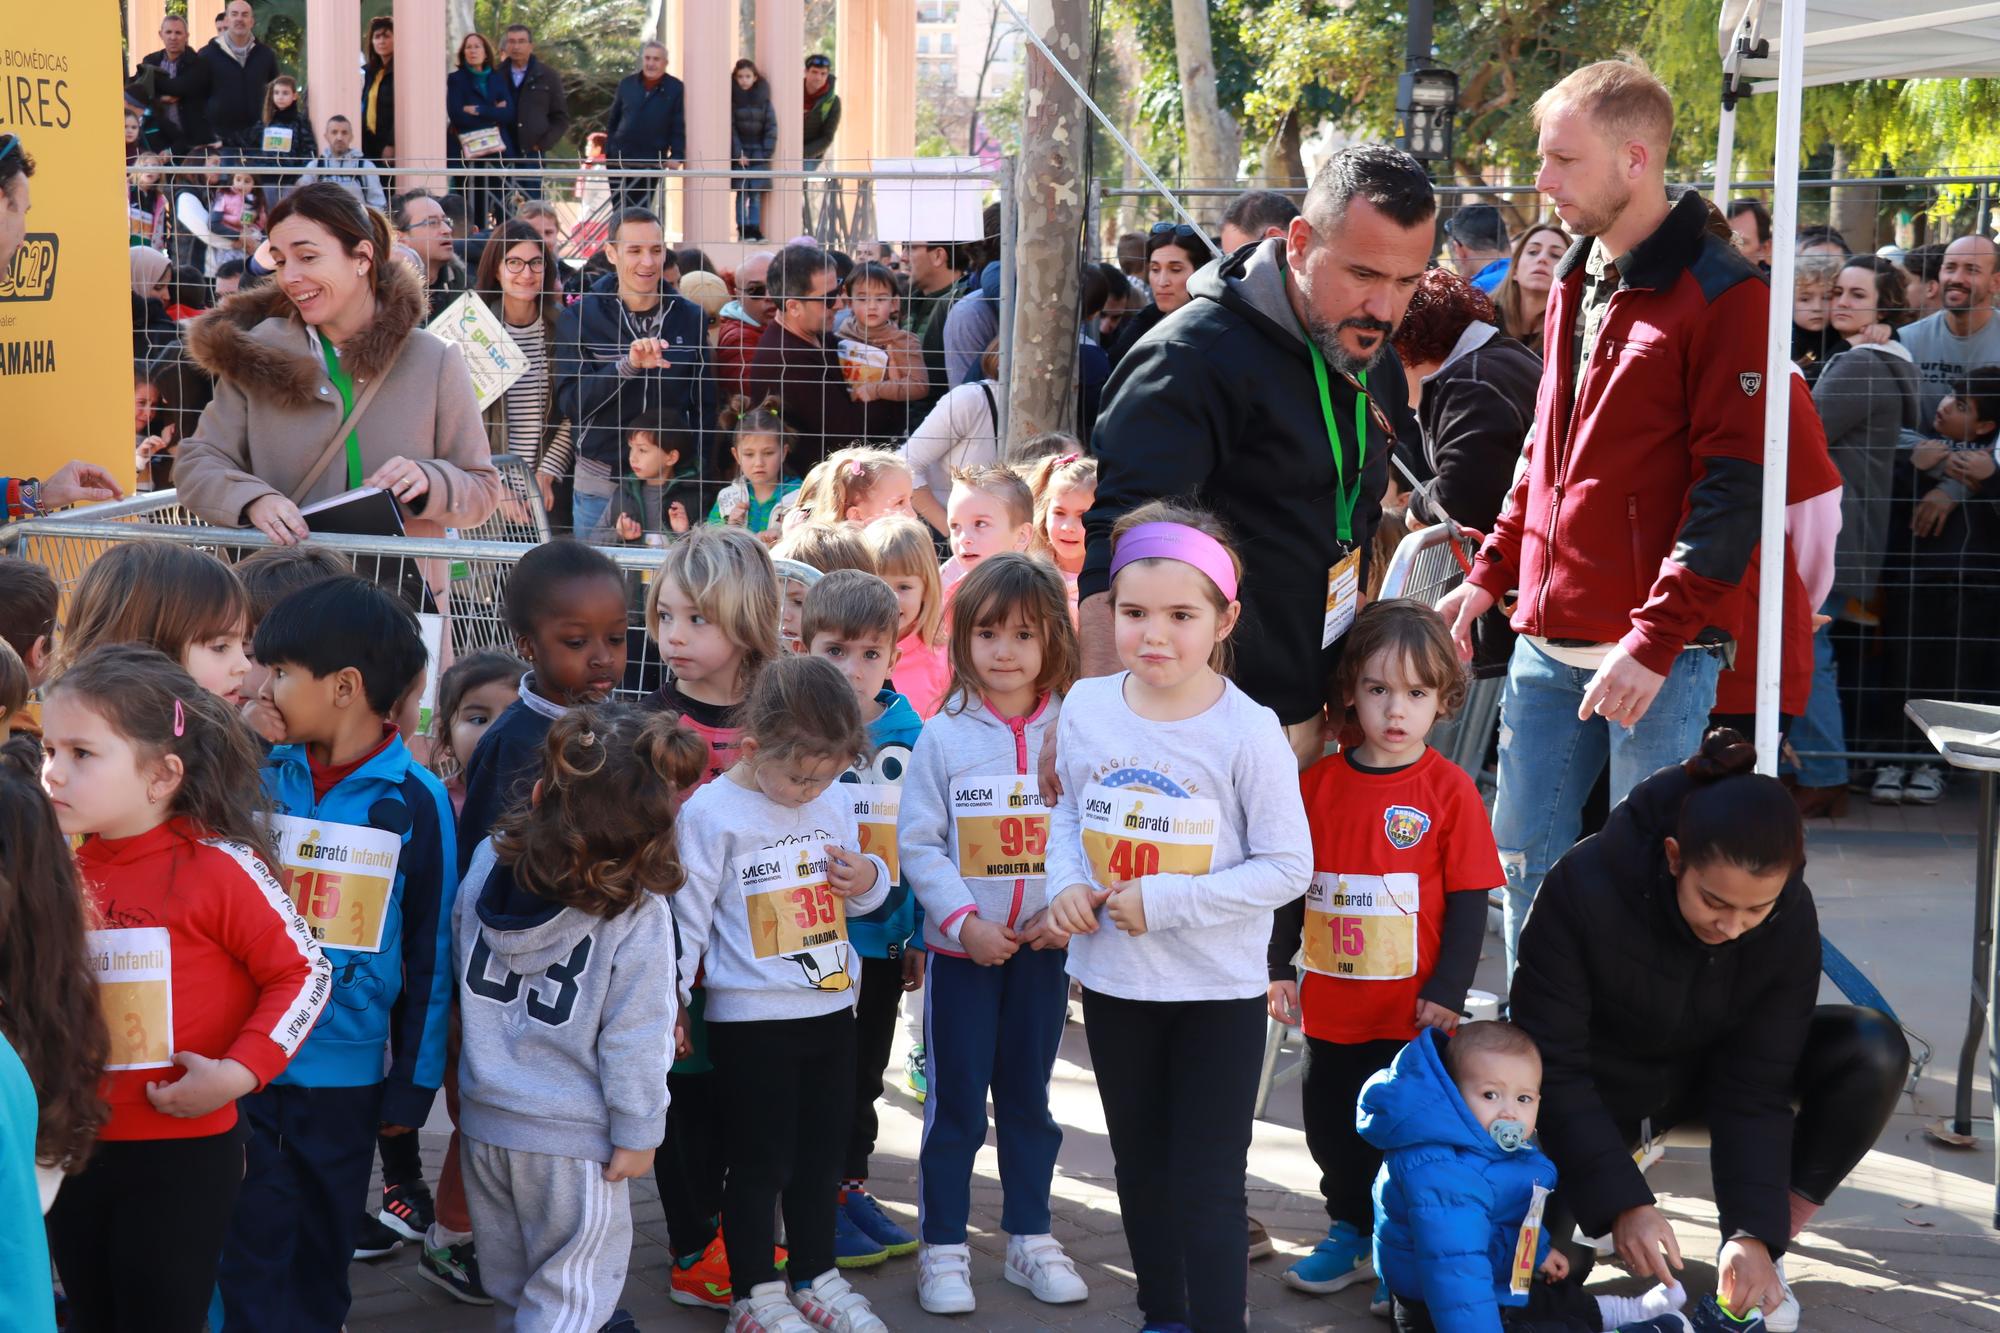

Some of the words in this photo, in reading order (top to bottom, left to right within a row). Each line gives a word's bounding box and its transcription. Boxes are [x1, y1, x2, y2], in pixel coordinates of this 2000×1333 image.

[5, 48, 68, 72] BIOMÉDICAS
[0, 75, 71, 129] IRES
[16, 245, 51, 289] C2P
[0, 315, 16, 328] aler
[855, 800, 869, 815] ató
[955, 788, 993, 801] SALERA
[1010, 794, 1044, 806] marat
[1086, 799, 1112, 815] SALERA
[1124, 814, 1170, 833] marató
[1172, 816, 1214, 836] Infantil
[1000, 816, 1047, 857] 95
[298, 843, 348, 863] marató
[351, 848, 394, 869] Infantil
[1108, 839, 1160, 881] 40
[742, 860, 782, 880] SALERA
[987, 863, 1030, 875] NICOLETA
[791, 883, 837, 929] 35
[1334, 892, 1373, 907] marató
[802, 929, 839, 948] ARIADNA
[1327, 916, 1365, 956] 15
[113, 950, 164, 971] Infantil
[1338, 962, 1354, 974] PAU
